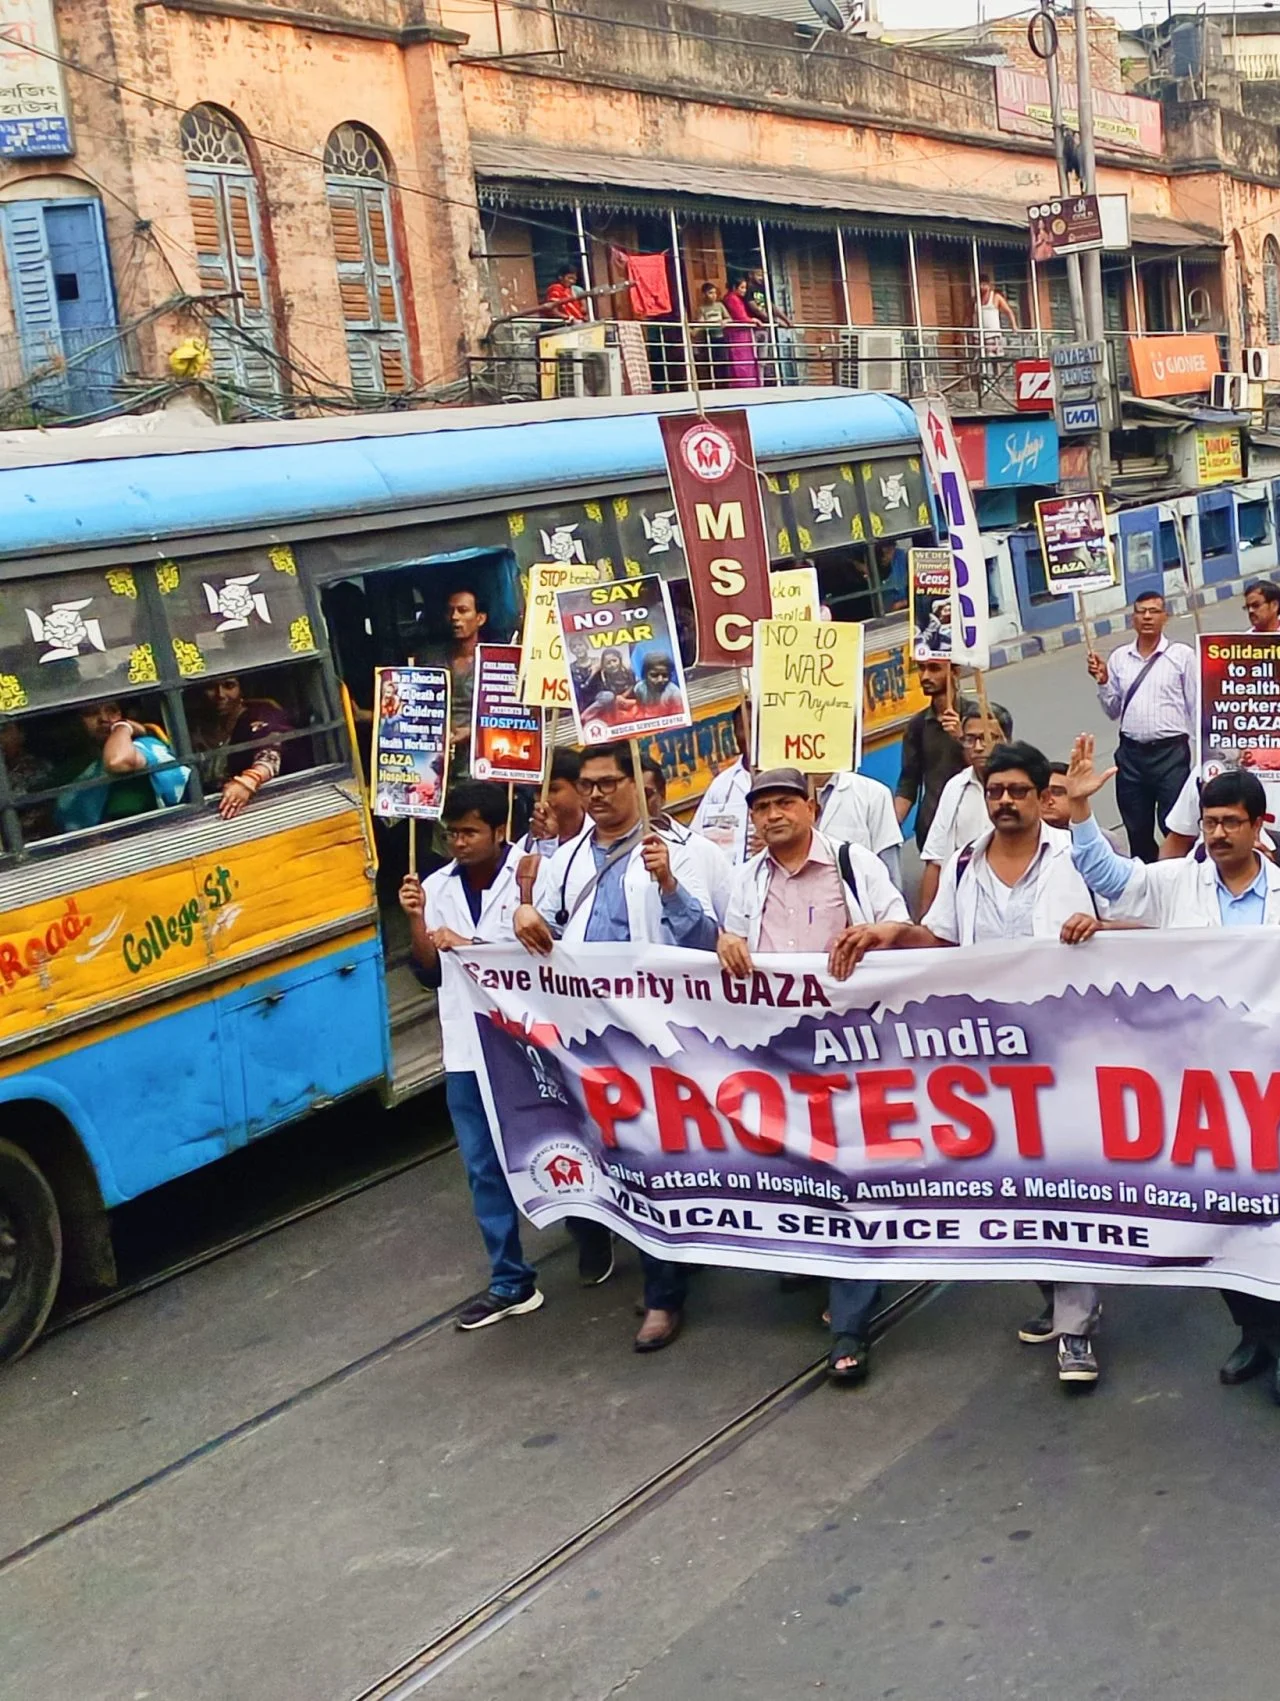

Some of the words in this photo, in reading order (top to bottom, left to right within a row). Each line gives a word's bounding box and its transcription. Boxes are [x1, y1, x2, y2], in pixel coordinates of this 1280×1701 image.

[540, 569, 567, 587] STOP
[695, 501, 753, 652] MSC
[1052, 561, 1087, 575] GAZA
[591, 581, 643, 606] SAY
[573, 610, 614, 631] NO
[620, 607, 649, 622] TO
[588, 624, 654, 650] WAR
[764, 625, 798, 648] NO
[784, 653, 845, 687] WAR
[1227, 662, 1247, 678] to
[1251, 662, 1274, 678] all
[541, 677, 571, 701] MS
[1221, 680, 1280, 695] Health
[402, 704, 444, 718] Children
[480, 716, 539, 731] HOSPITAL
[1212, 716, 1229, 731] in
[785, 733, 827, 761] MSC
[379, 753, 414, 766] GAZA
[378, 769, 421, 785] Hospitals
[123, 897, 203, 974] College
[204, 865, 240, 910] St.
[539, 966, 675, 1005] Humanity
[686, 972, 712, 1001] in
[721, 969, 831, 1009] GAZA
[813, 1025, 881, 1065] All
[895, 1017, 1029, 1059] India
[581, 1064, 1055, 1164] PROTEST
[649, 1166, 721, 1190] attack
[727, 1172, 751, 1190] on
[756, 1172, 849, 1203] Hospitals,
[856, 1178, 994, 1200] Ambulances
[1000, 1178, 1018, 1198] &
[1024, 1178, 1113, 1203] Medicos
[1119, 1182, 1138, 1204] in
[1143, 1184, 1198, 1213] Gaza,
[778, 1213, 961, 1241] SERVICE
[979, 1218, 1151, 1248] CENTRE
